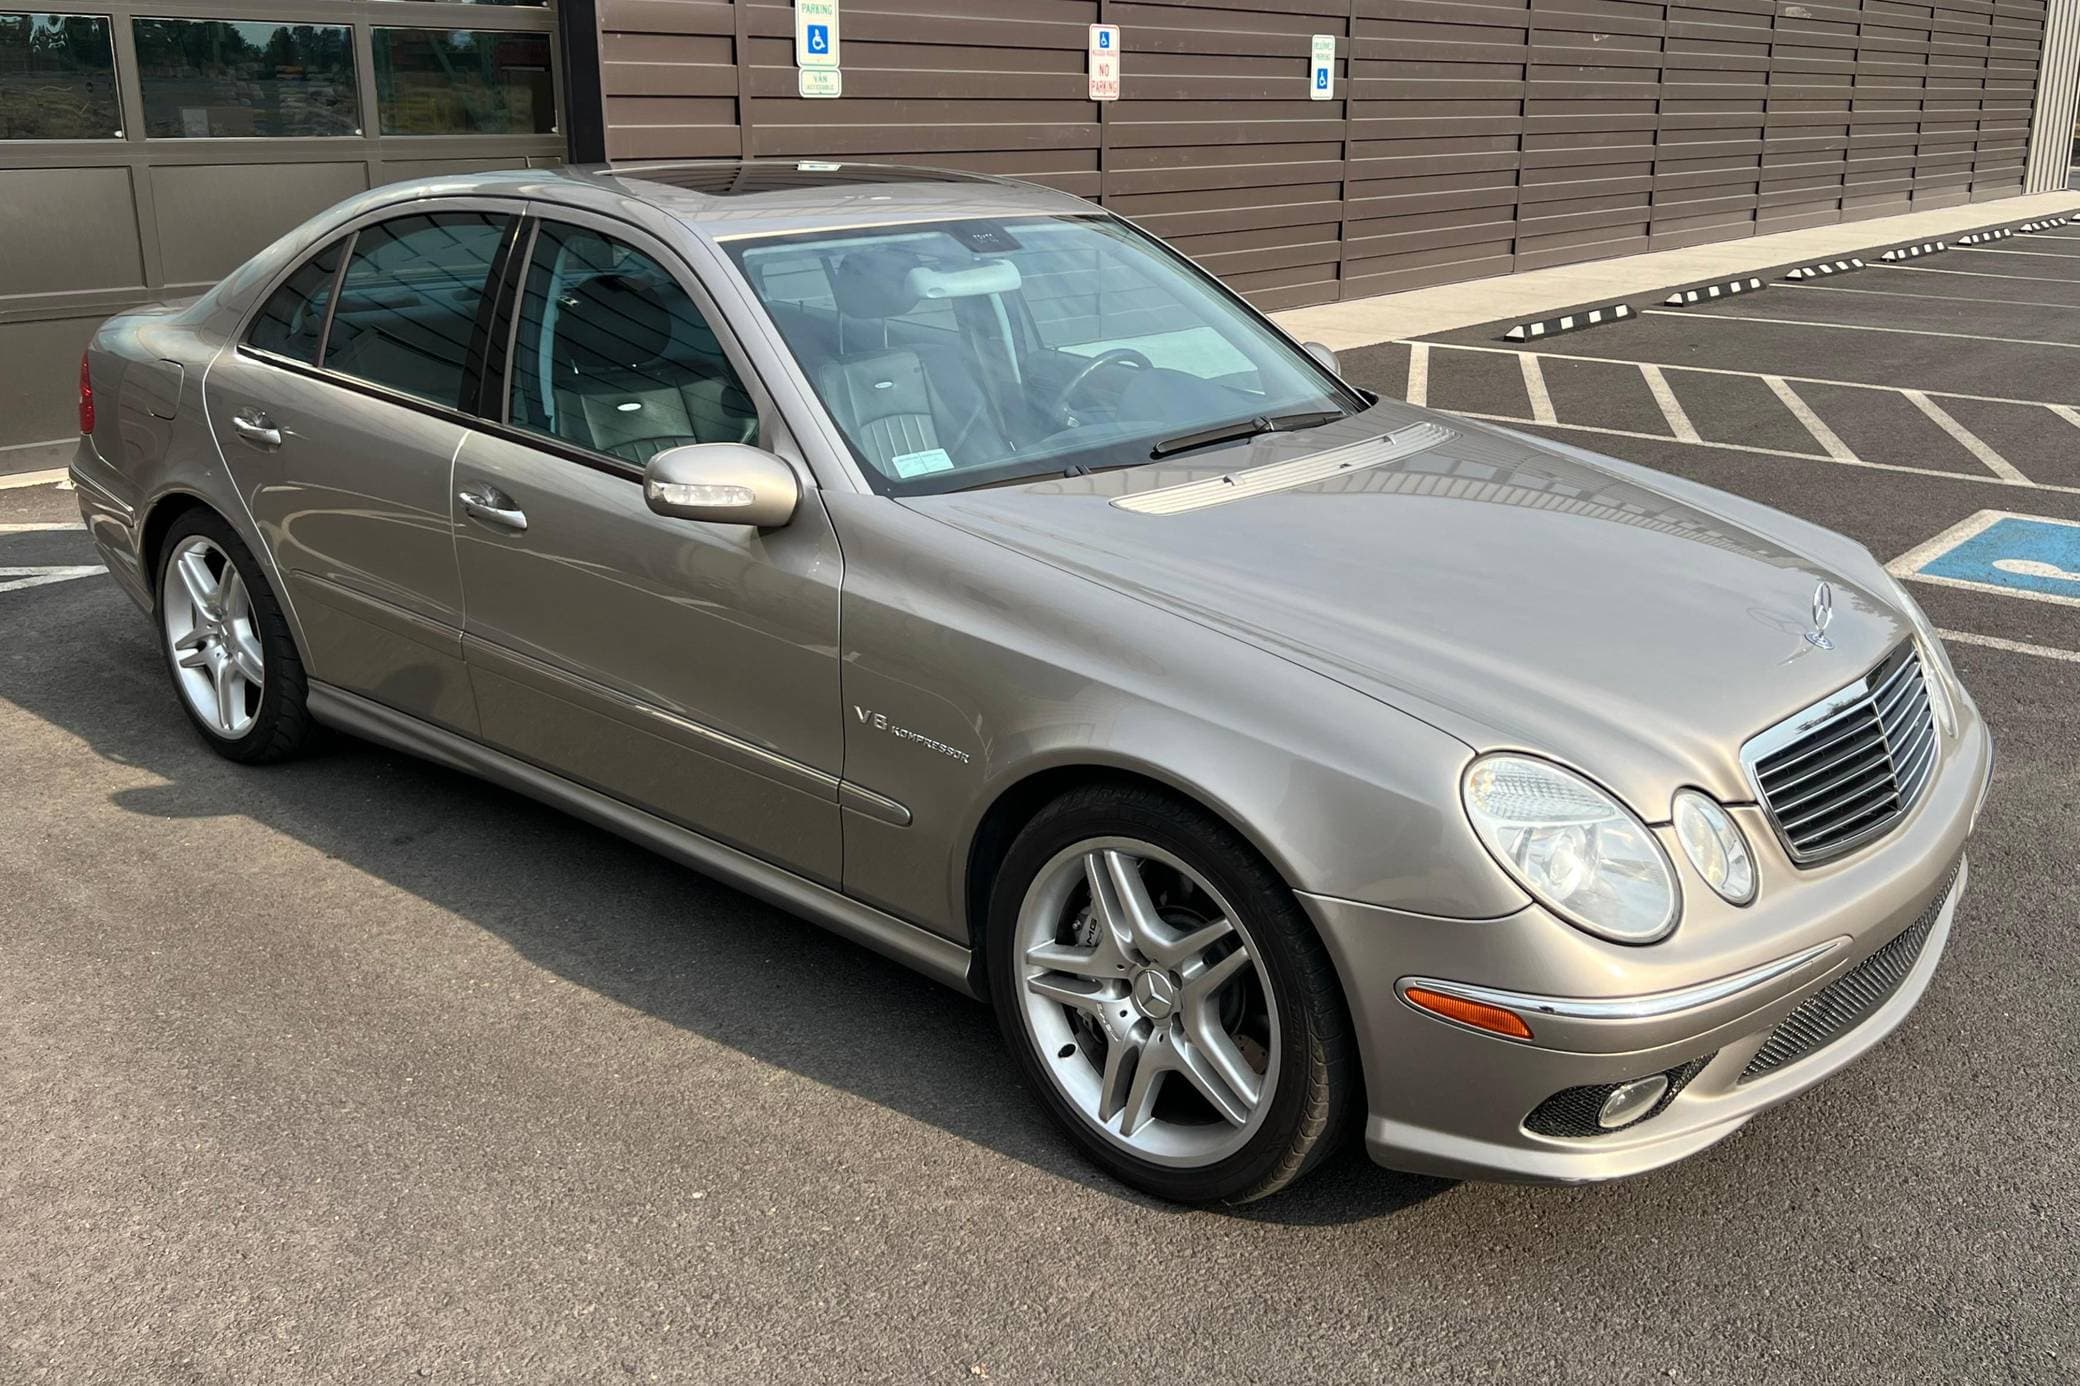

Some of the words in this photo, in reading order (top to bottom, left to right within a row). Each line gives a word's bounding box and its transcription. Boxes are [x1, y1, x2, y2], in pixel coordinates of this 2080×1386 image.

[801, 3, 833, 16] PARKING
[1099, 63, 1110, 77] NO
[813, 75, 828, 83] VAN
[1091, 80, 1117, 94] PARKING
[854, 705, 888, 731] V8
[891, 725, 970, 764] KOMPRESSOR
[1086, 918, 1098, 946] MG
